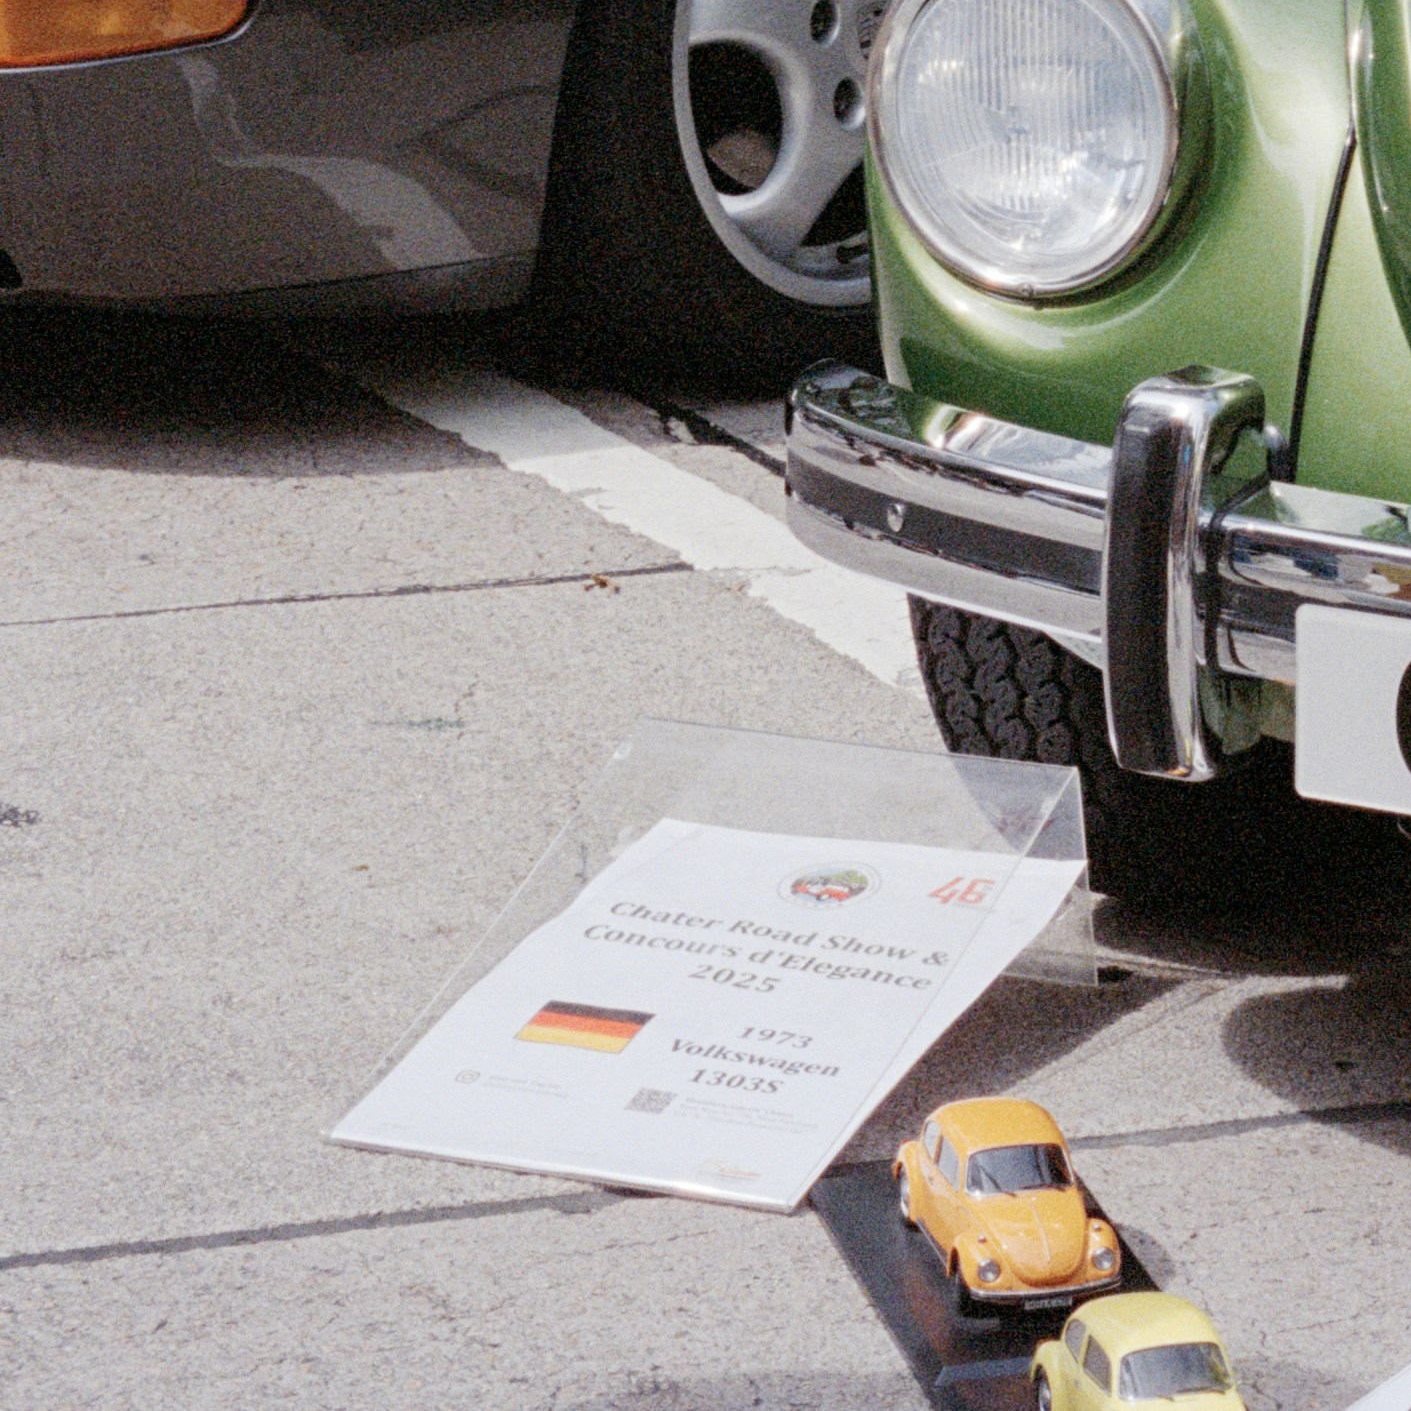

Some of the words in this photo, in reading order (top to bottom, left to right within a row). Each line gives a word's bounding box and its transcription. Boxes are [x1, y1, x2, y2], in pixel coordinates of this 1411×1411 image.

[927, 876, 996, 905] 46
[610, 900, 722, 931] Chater
[727, 919, 817, 947] Road
[820, 934, 917, 959] Show
[921, 951, 951, 968] &
[583, 924, 742, 959] Concours
[748, 949, 933, 991] d'Elegance
[687, 963, 781, 993] 2025
[737, 1026, 814, 1049] 1973
[670, 1038, 841, 1078] Volkswagen
[688, 1068, 785, 1094] 1303S
